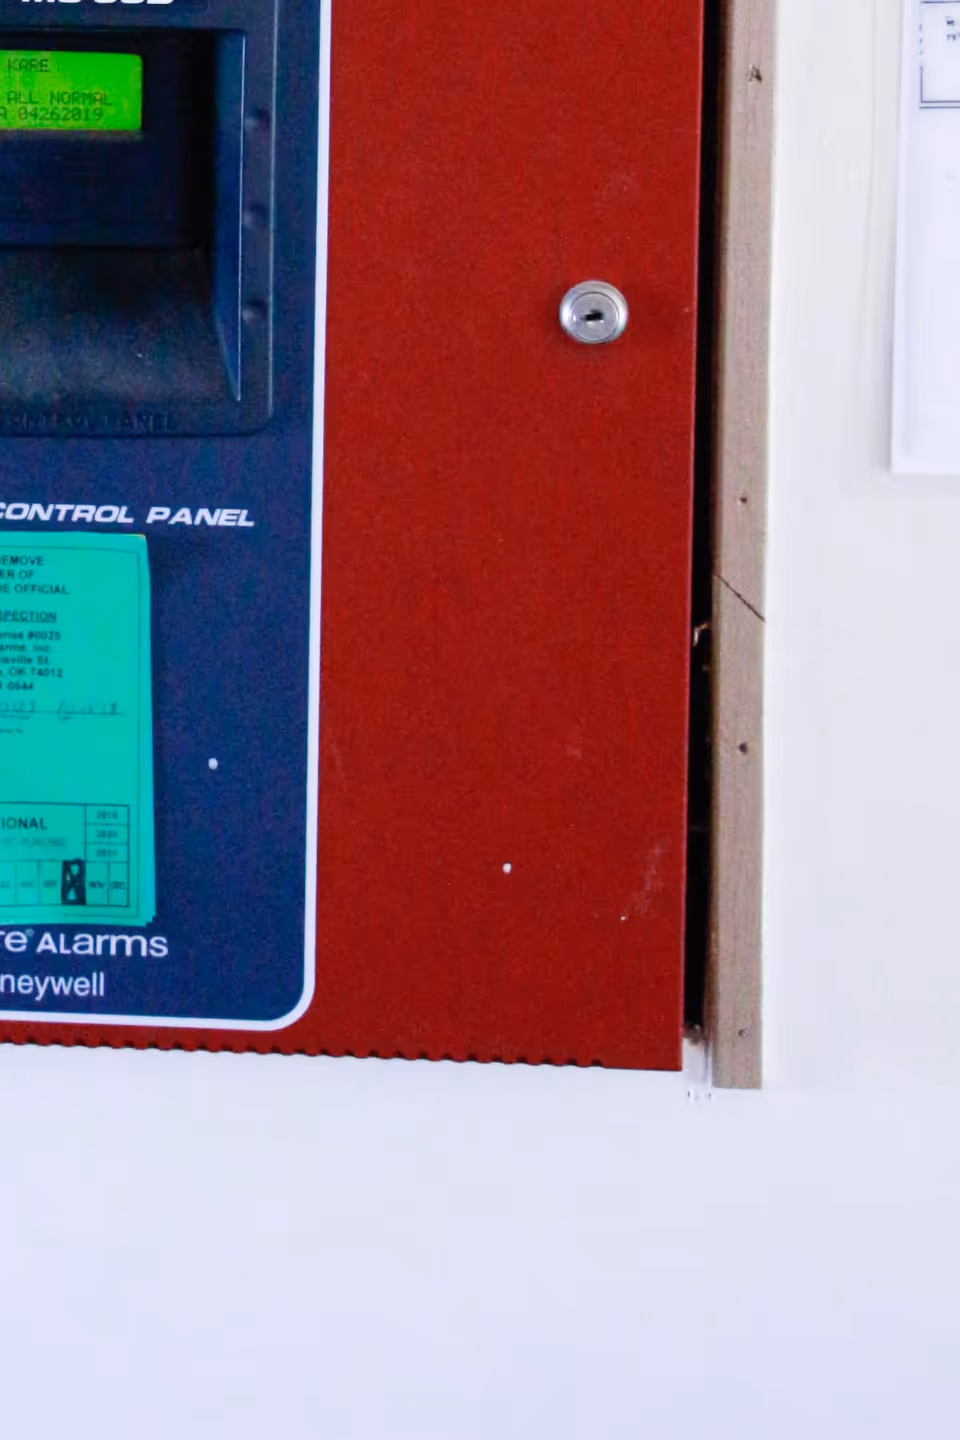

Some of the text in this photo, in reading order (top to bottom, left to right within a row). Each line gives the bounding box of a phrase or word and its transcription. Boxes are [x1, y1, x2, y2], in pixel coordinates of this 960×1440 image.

[7, 58, 49, 73] KARE
[7, 90, 39, 106] ALL
[50, 91, 112, 106] NORMAL
[18, 108, 104, 123] 04262019
[145, 506, 255, 527] PANEL
[19, 570, 34, 580] OF
[14, 584, 69, 595] OFFICIAL
